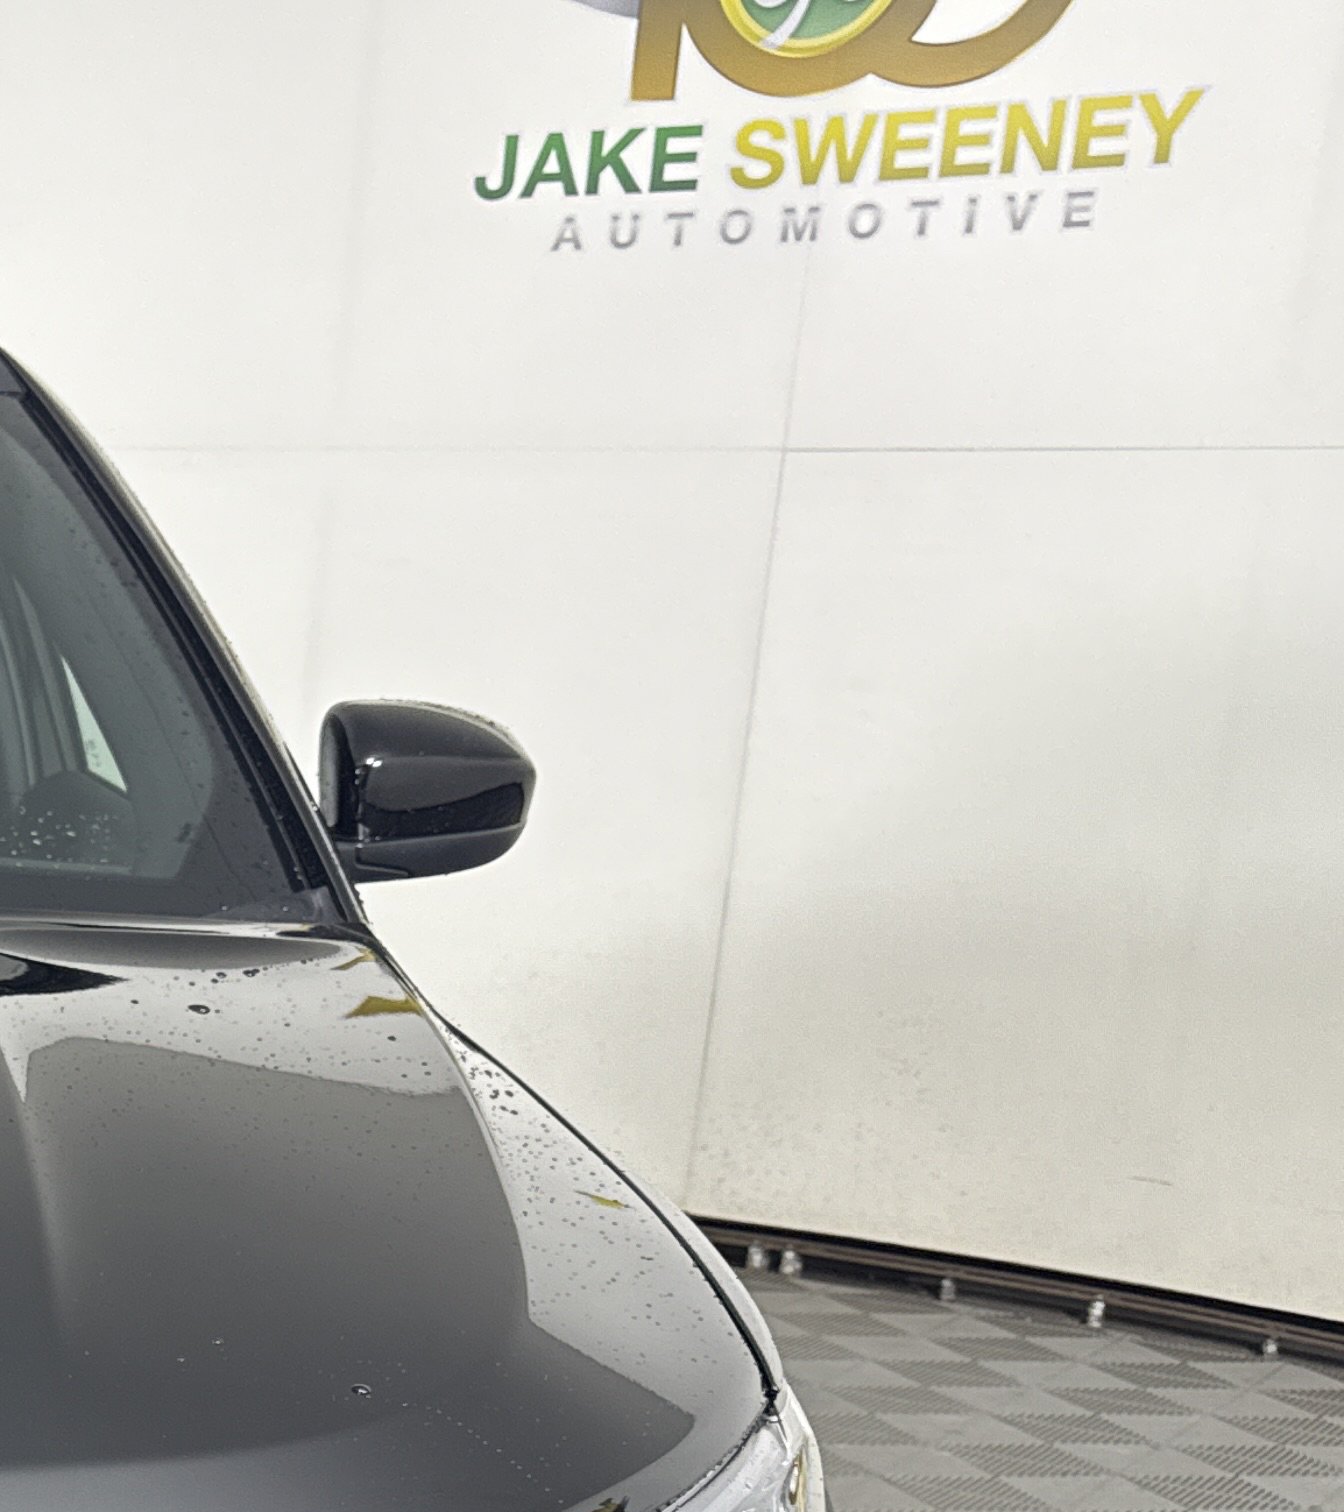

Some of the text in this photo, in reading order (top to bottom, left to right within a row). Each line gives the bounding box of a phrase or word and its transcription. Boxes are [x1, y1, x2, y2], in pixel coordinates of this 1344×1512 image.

[473, 87, 1205, 202] JAKE SWEENEY
[551, 192, 1098, 252] AUTOMOTIVE
